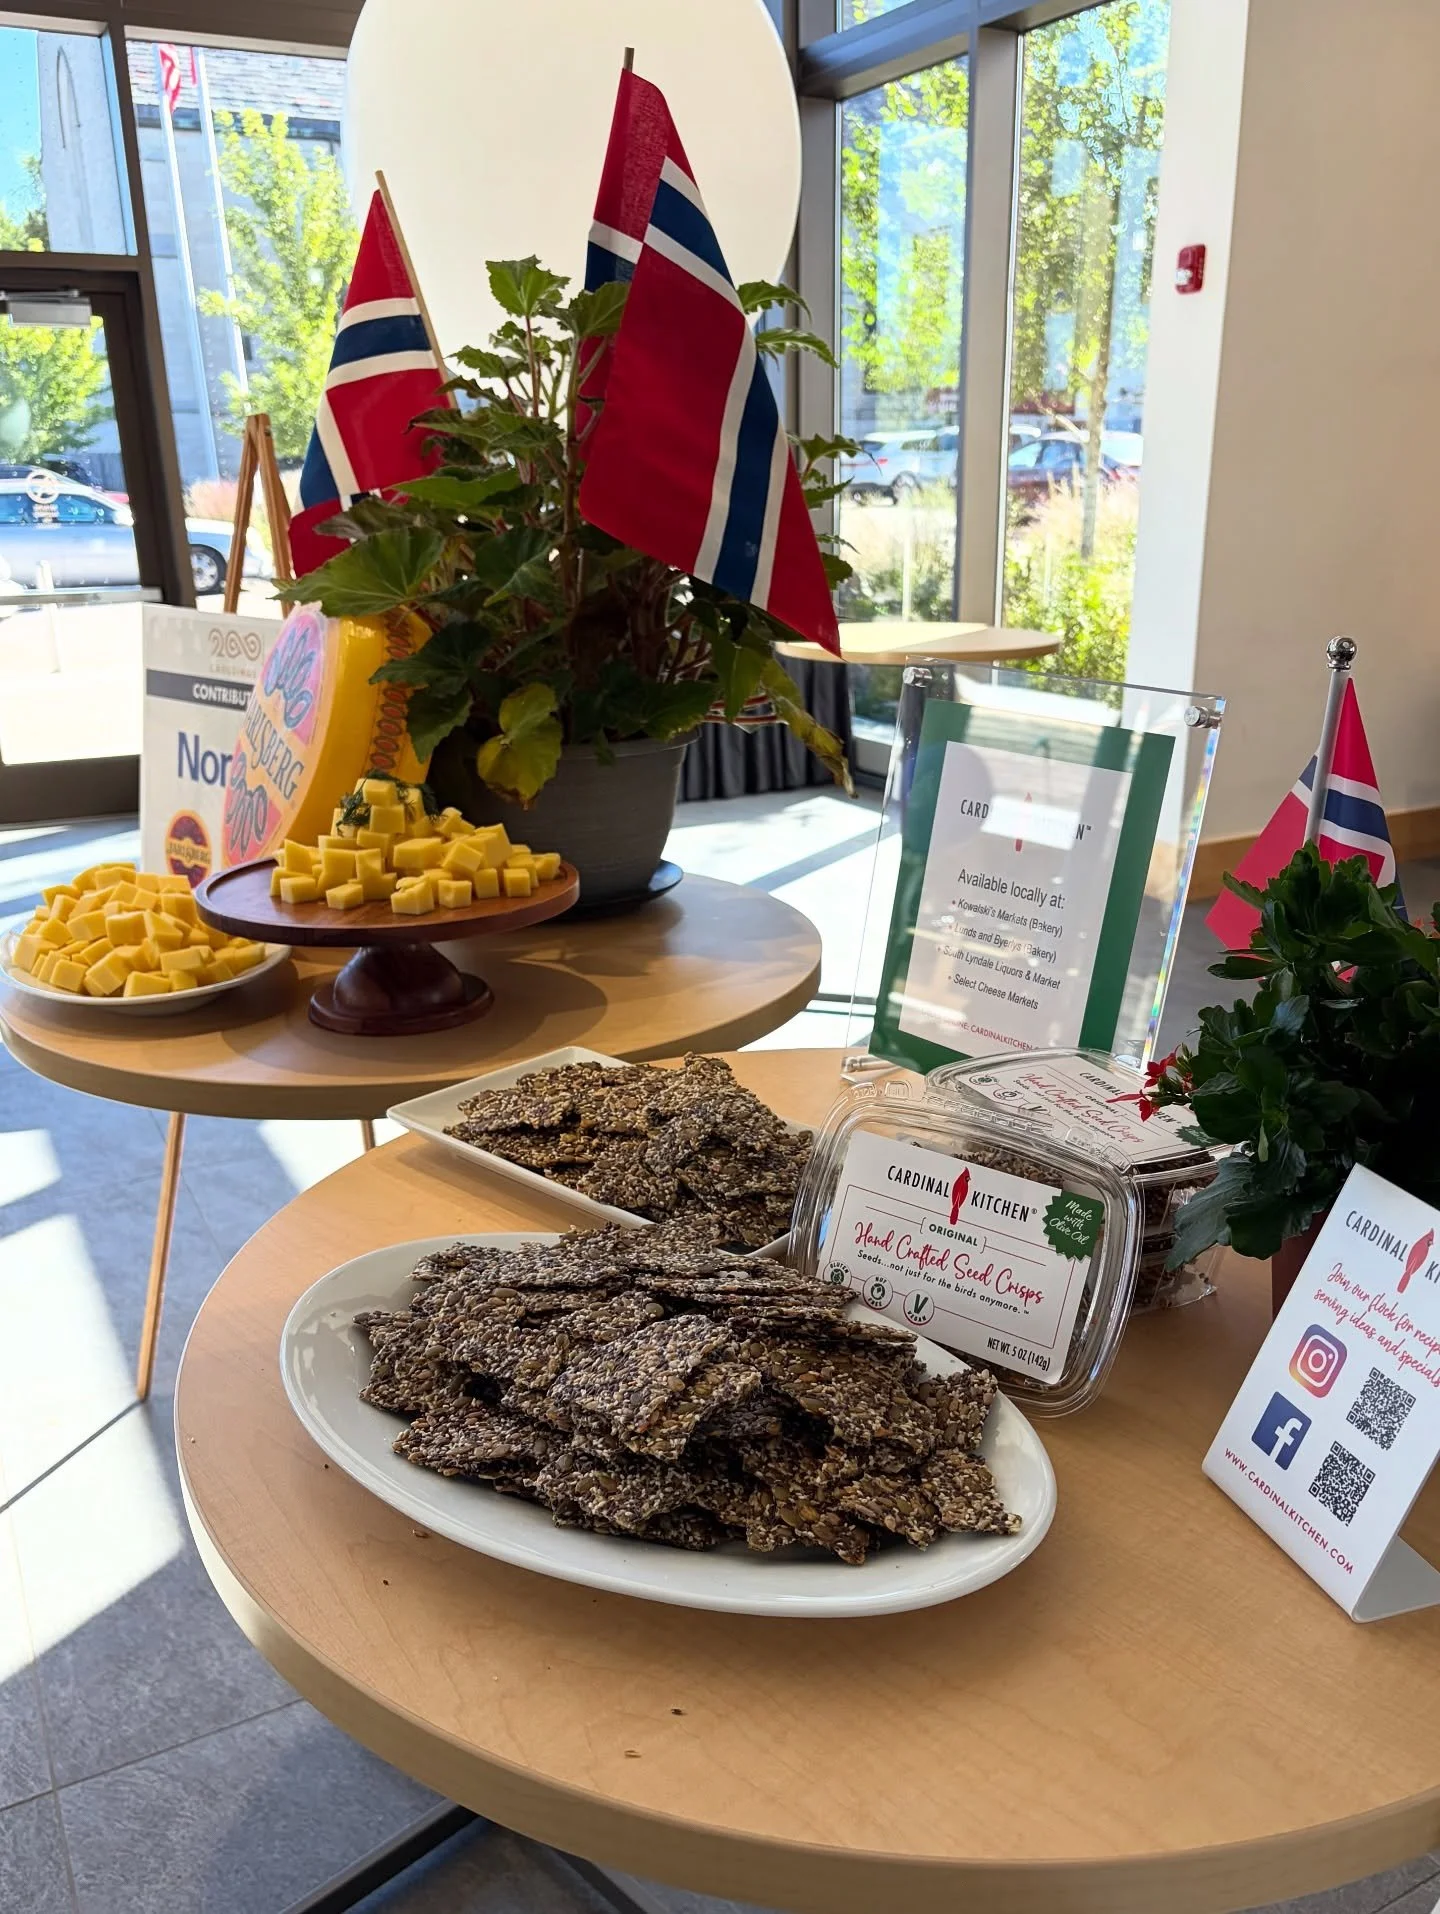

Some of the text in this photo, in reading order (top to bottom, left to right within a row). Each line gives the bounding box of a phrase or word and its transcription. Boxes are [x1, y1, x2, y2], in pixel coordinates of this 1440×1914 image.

[958, 868, 1066, 909] Available locally at:
[957, 898, 1063, 939] Kowalski's Markets (Bakery)
[954, 922, 1057, 963] Lunds and Byerlys (Bakery)
[943, 945, 1061, 990] South Lyndale Liquors & Market
[953, 973, 1039, 1010] Select Cheese Markets
[1080, 1072, 1126, 1096] CARDINAL
[1018, 1073, 1056, 1089] Hand
[1045, 1089, 1091, 1110] Crafted
[1081, 1109, 1115, 1126] Seed
[1107, 1125, 1144, 1143] Crisps
[1085, 1095, 1119, 1114] ORIGINAL
[887, 1165, 950, 1198] CARDINAL
[1063, 1215, 1085, 1230] with
[1065, 1200, 1093, 1221] Made
[928, 1223, 978, 1247] ORIGINAL
[1049, 1217, 1090, 1245] Olive Oil
[1345, 1210, 1408, 1262] CARDINAL
[830, 1263, 849, 1274] GLUTEN
[854, 1221, 1045, 1307] Hand Crafted Seed Crisps
[875, 1276, 887, 1284] NUT
[904, 1265, 921, 1278] just
[922, 1271, 936, 1284] for
[938, 1277, 951, 1289] the
[954, 1283, 977, 1298] birds
[867, 1297, 883, 1307] FREE
[907, 1310, 927, 1322] VEGAN
[1327, 1262, 1440, 1359] Join our flock for recip
[1313, 1288, 1350, 1326] serving
[1377, 1337, 1406, 1357] and
[987, 1337, 1051, 1372] NET WT. 5 OZ (142g)
[1225, 1447, 1354, 1574] WWW.CARDINALKITCHEN.COM
